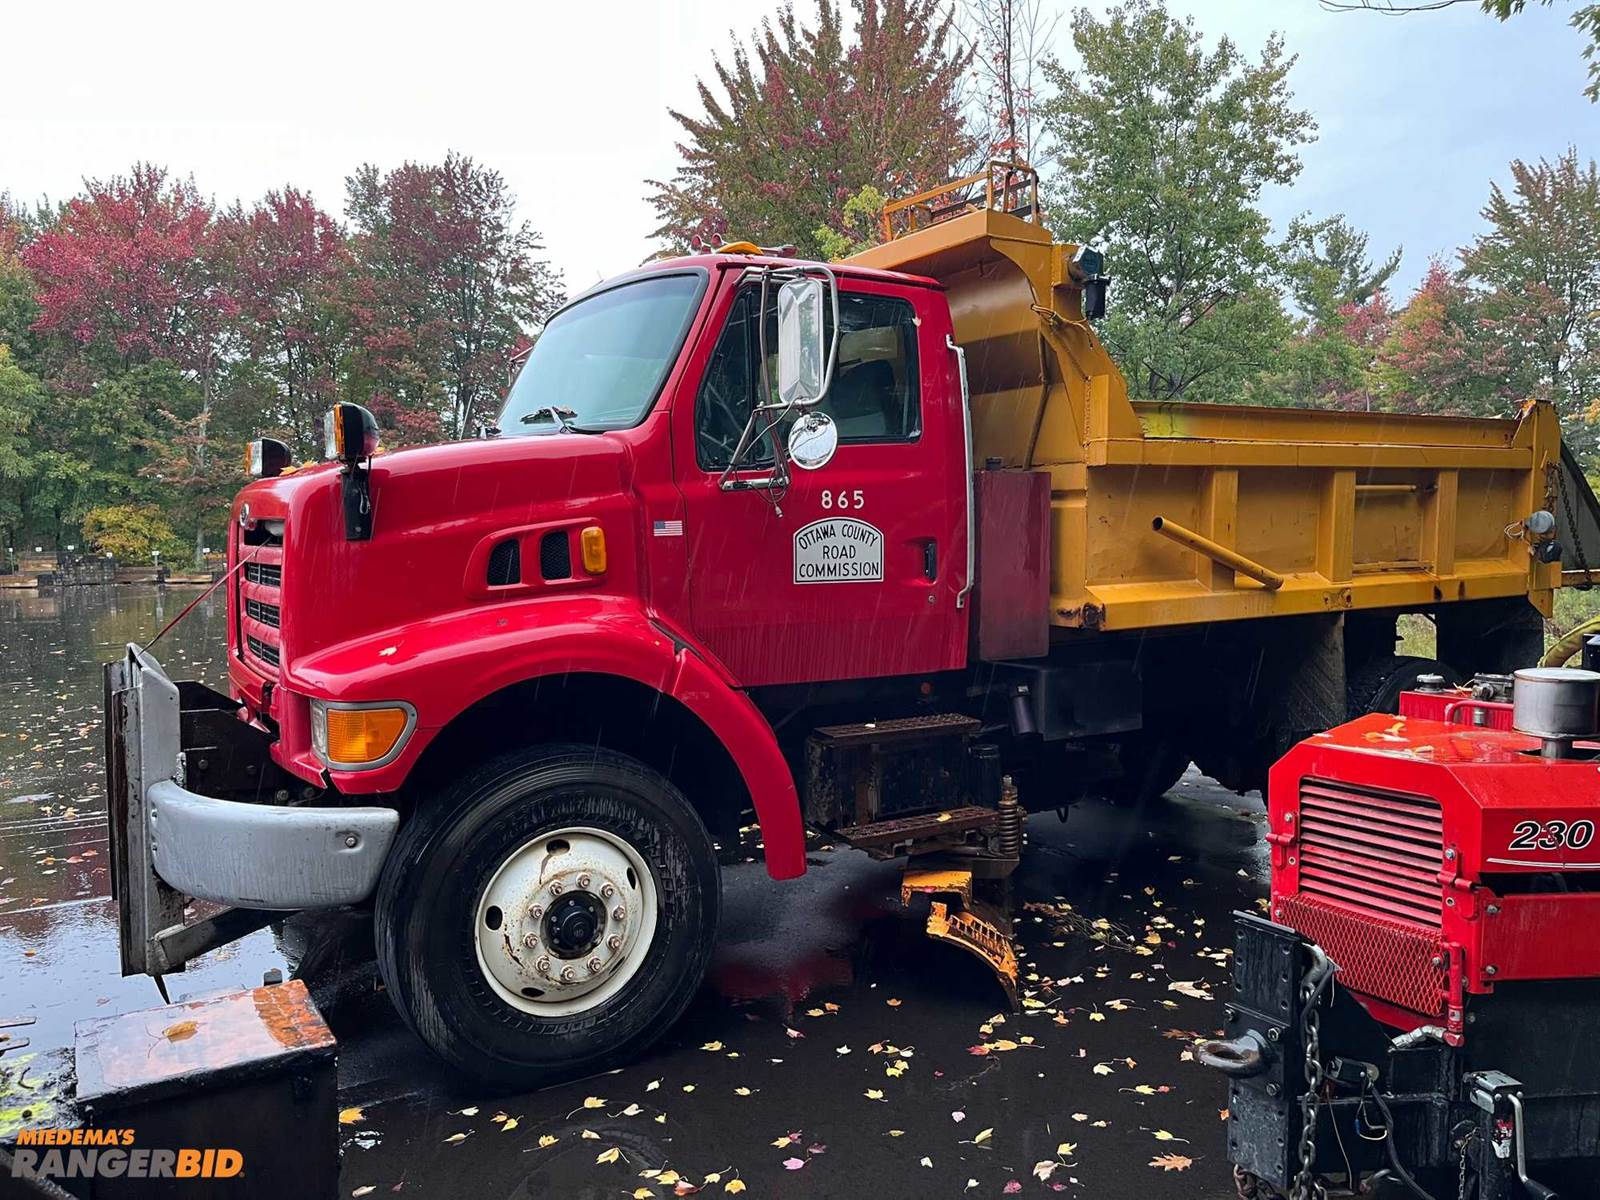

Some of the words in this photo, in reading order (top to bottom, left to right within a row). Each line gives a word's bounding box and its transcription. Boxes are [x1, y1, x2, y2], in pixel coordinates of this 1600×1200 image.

[821, 490, 864, 509] 865
[798, 524, 836, 550] OTTAWA
[841, 524, 878, 547] COUNTY
[822, 545, 856, 560] ROAD
[799, 562, 879, 578] COMMISSION
[1508, 819, 1595, 851] 230
